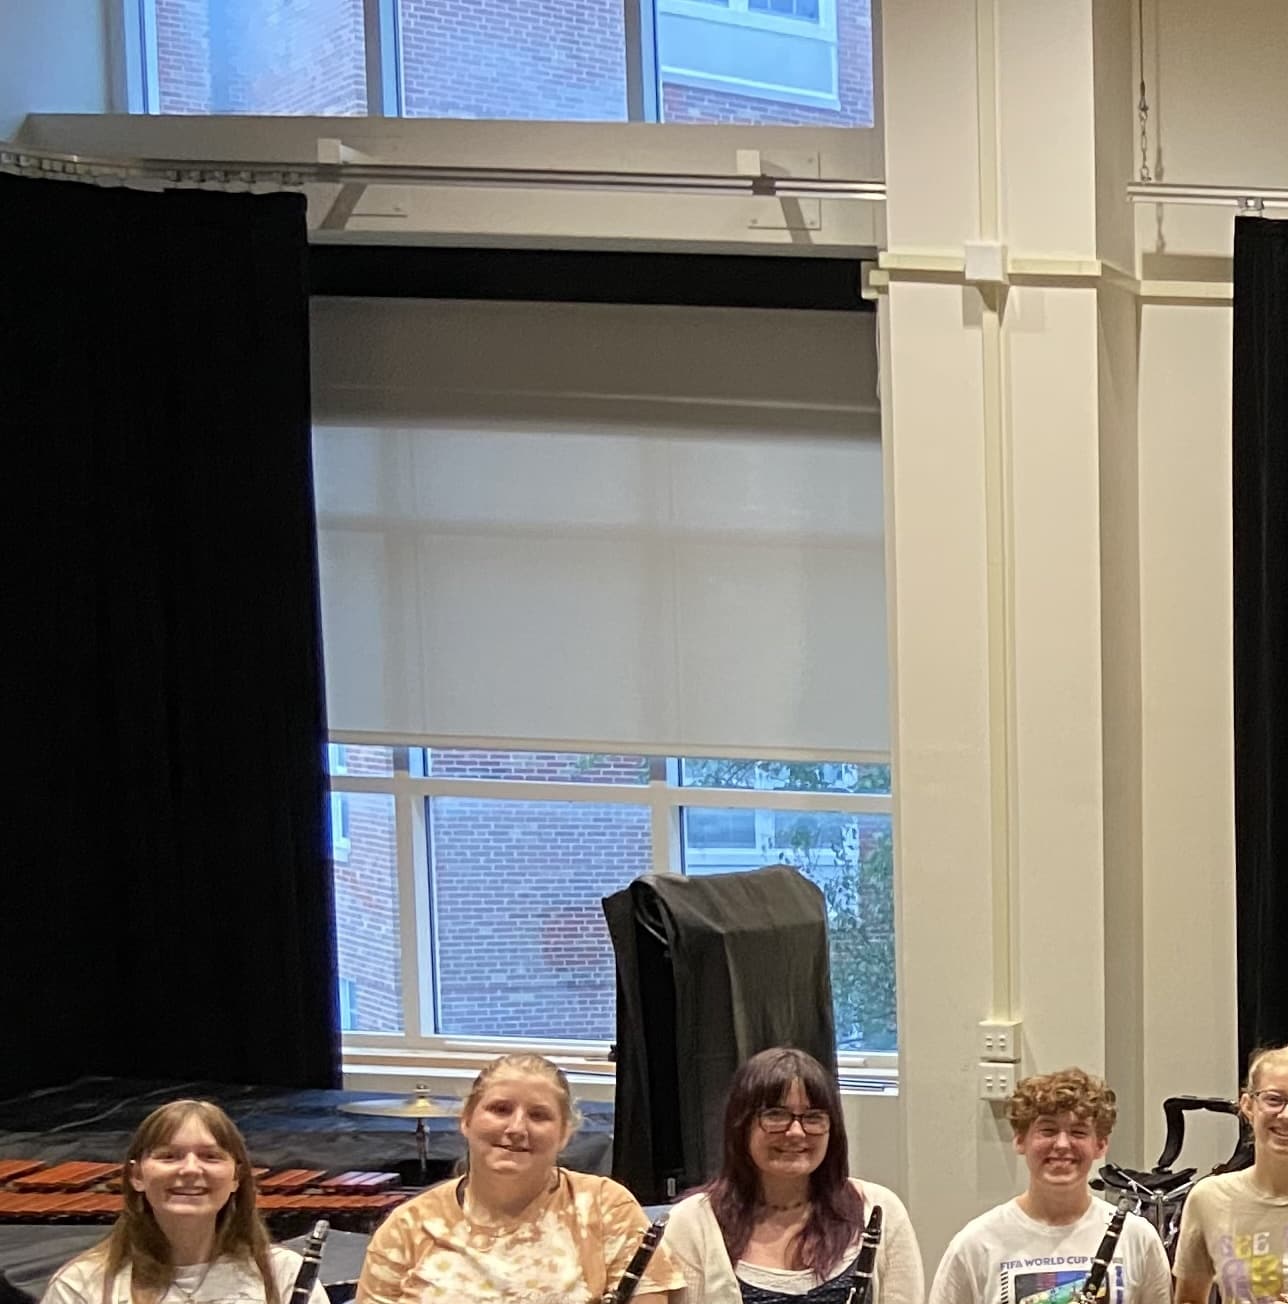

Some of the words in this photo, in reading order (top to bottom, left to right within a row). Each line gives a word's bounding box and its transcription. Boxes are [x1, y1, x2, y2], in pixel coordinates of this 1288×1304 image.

[1000, 1261, 1023, 1271] FIFA
[1024, 1257, 1065, 1268] WORLD
[1066, 1256, 1088, 1265] CUP
